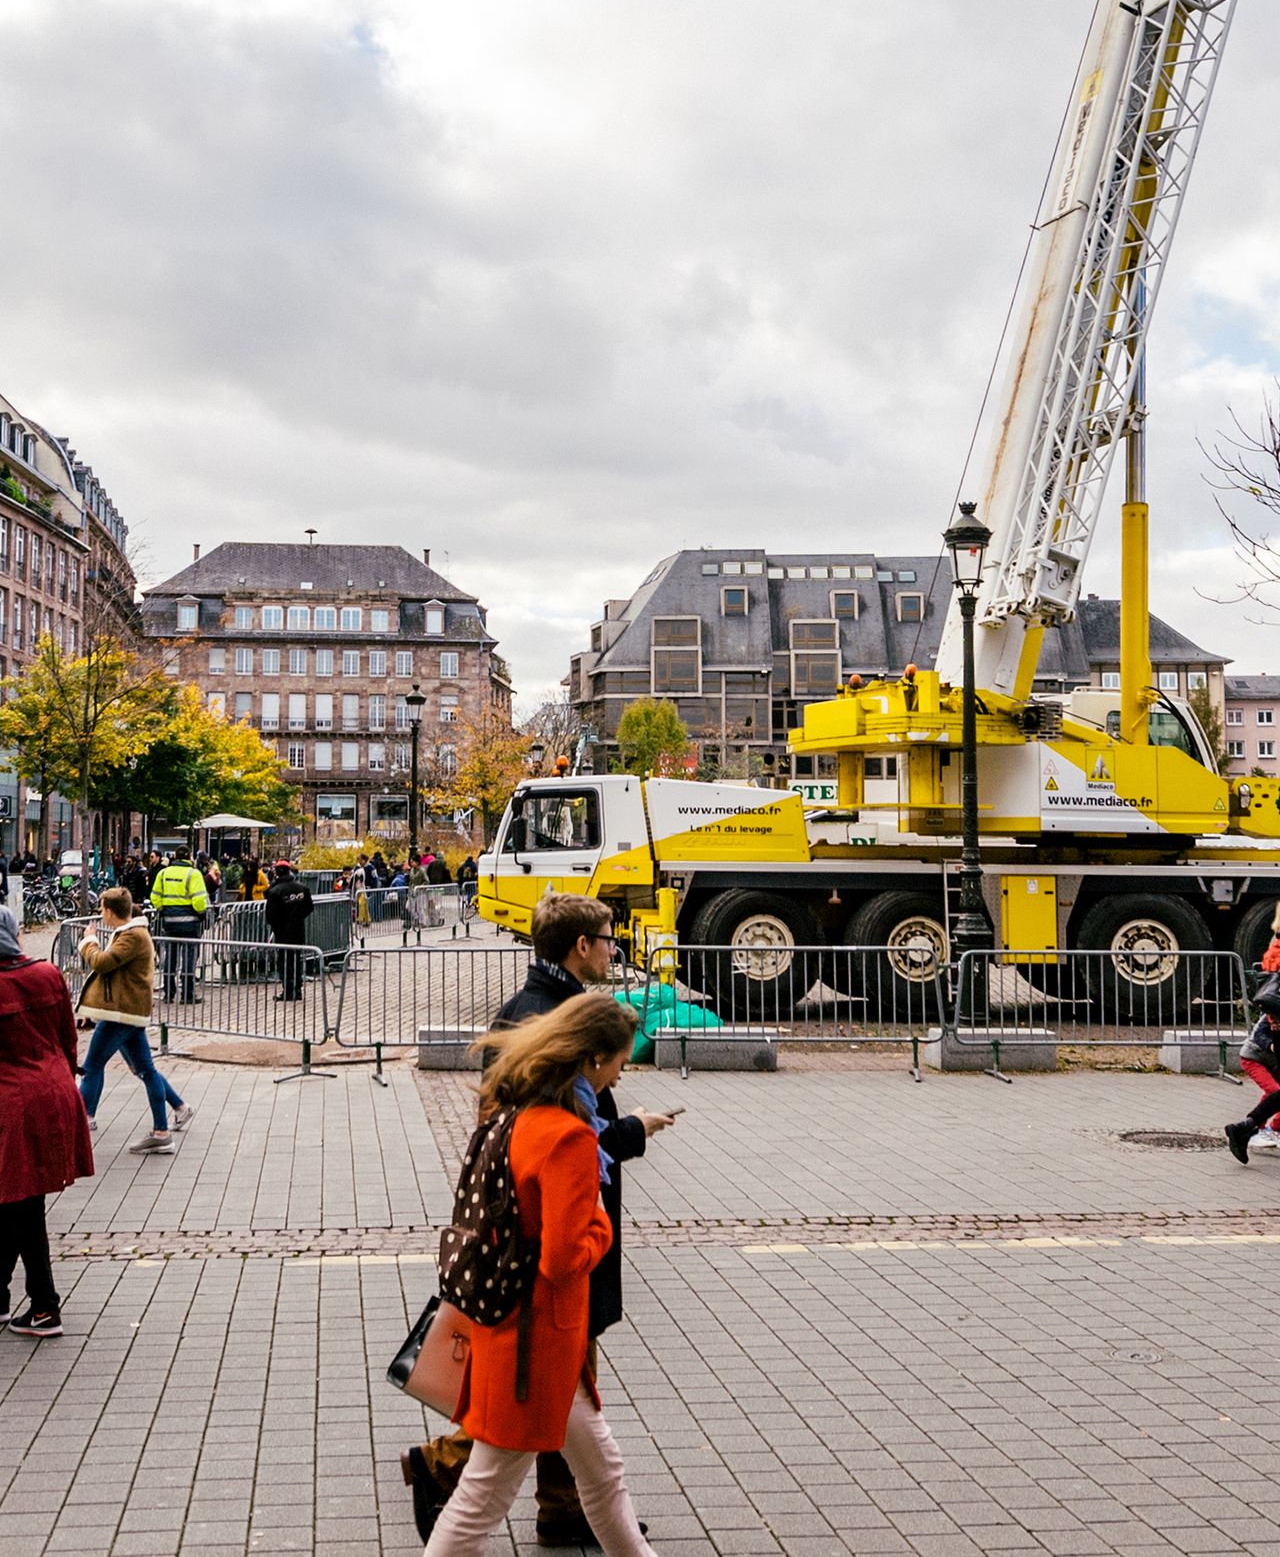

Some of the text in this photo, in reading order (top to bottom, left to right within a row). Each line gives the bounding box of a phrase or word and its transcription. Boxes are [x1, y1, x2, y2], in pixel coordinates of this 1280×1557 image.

[788, 785, 838, 800] STE
[1048, 796, 1153, 808] www.mediaco.fr
[678, 805, 782, 815] www.mediaco.fr
[690, 825, 703, 833] Le
[724, 825, 737, 833] du
[740, 826, 772, 834] levage
